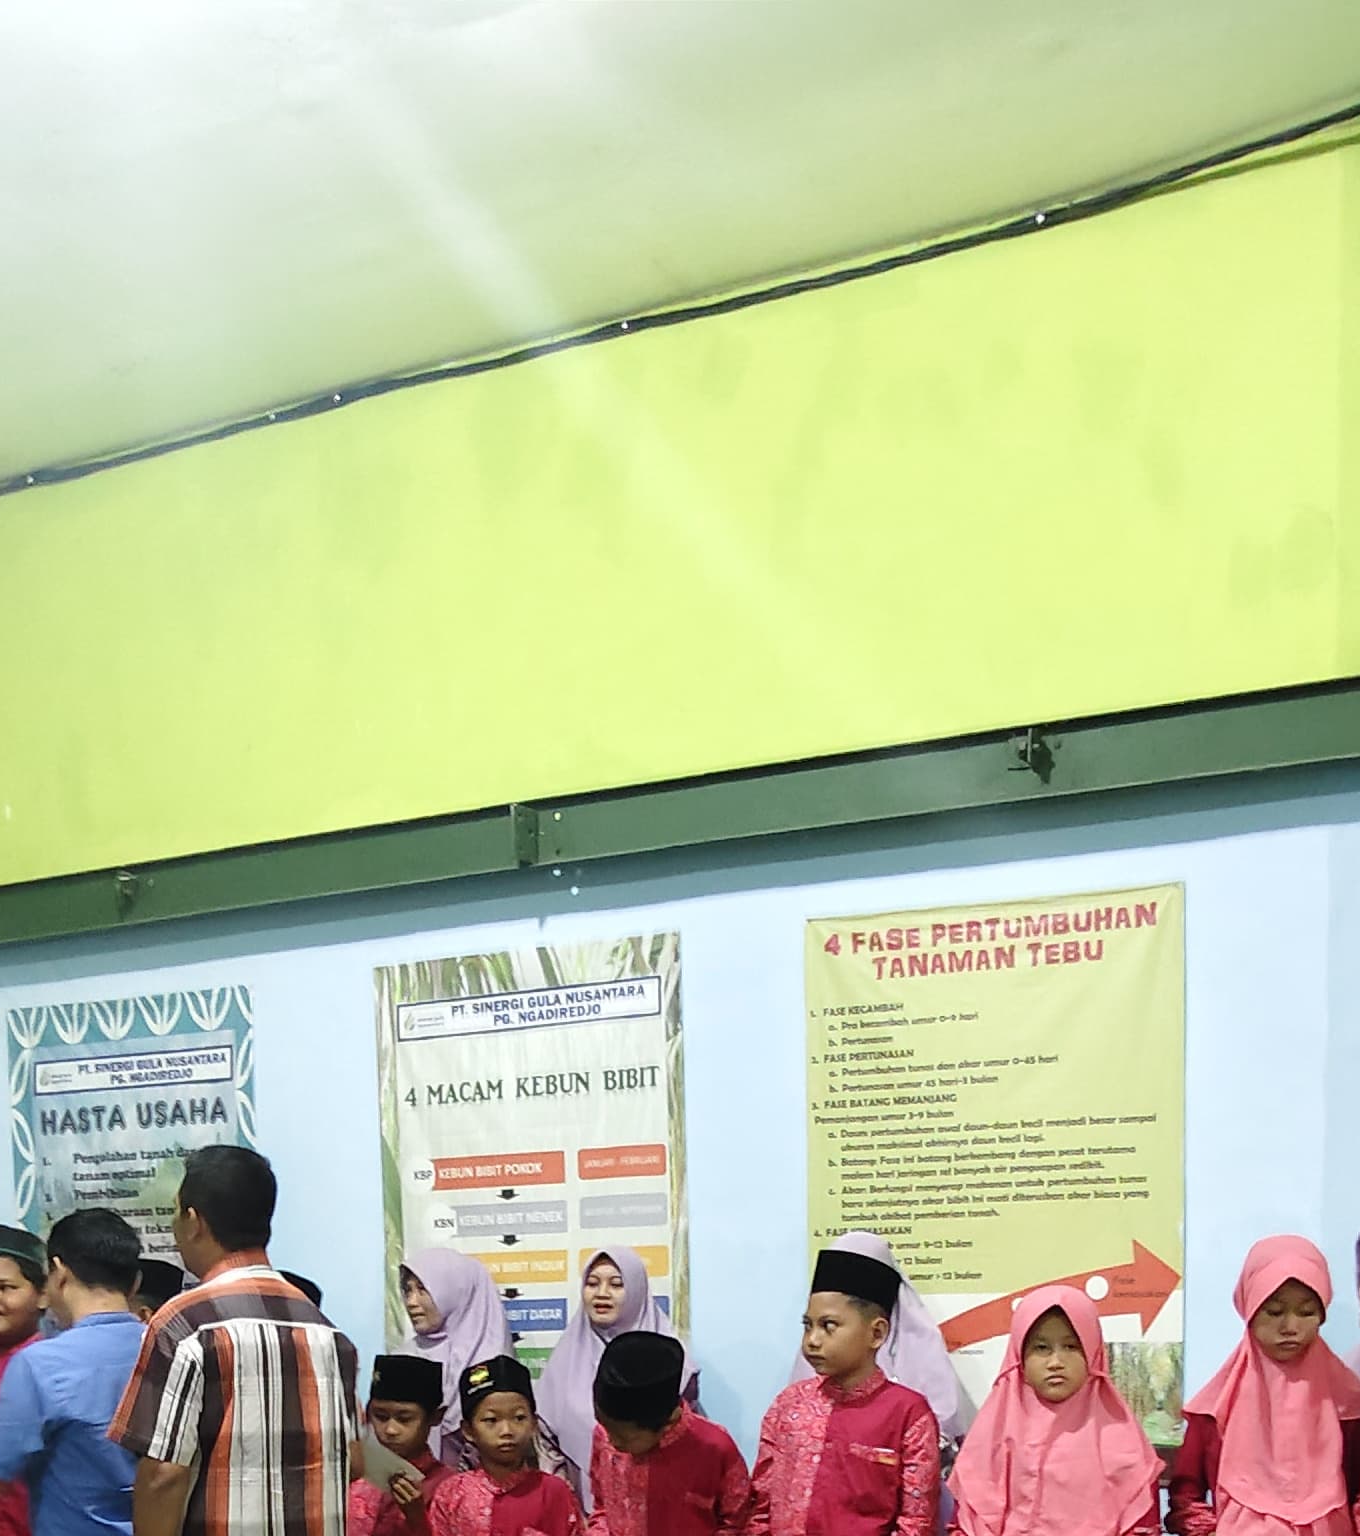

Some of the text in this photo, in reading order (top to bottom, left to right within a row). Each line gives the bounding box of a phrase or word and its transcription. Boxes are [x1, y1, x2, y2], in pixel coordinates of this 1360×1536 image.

[823, 902, 1157, 955] 4 FASE PERTUMBUHAN
[872, 940, 1103, 980] TANAMAN TEBU
[451, 985, 645, 1017] PT. SINERGI GULA NUSANTARA
[493, 1004, 601, 1026] PG. NGADIREDJO
[823, 1007, 846, 1016] FASE
[823, 1049, 915, 1063] FASE PERTUNASAN
[427, 1079, 504, 1105] MACAM
[516, 1071, 591, 1098] KEBUN
[604, 1065, 660, 1091] BIBIT
[824, 1100, 847, 1109] FASE
[850, 1097, 890, 1107] BATANG
[40, 1096, 228, 1137] HASTA USAHA
[413, 1169, 433, 1181] KBP
[438, 1161, 543, 1180] KEBUN BIBIT POKOK
[529, 1307, 563, 1321] DATAR
